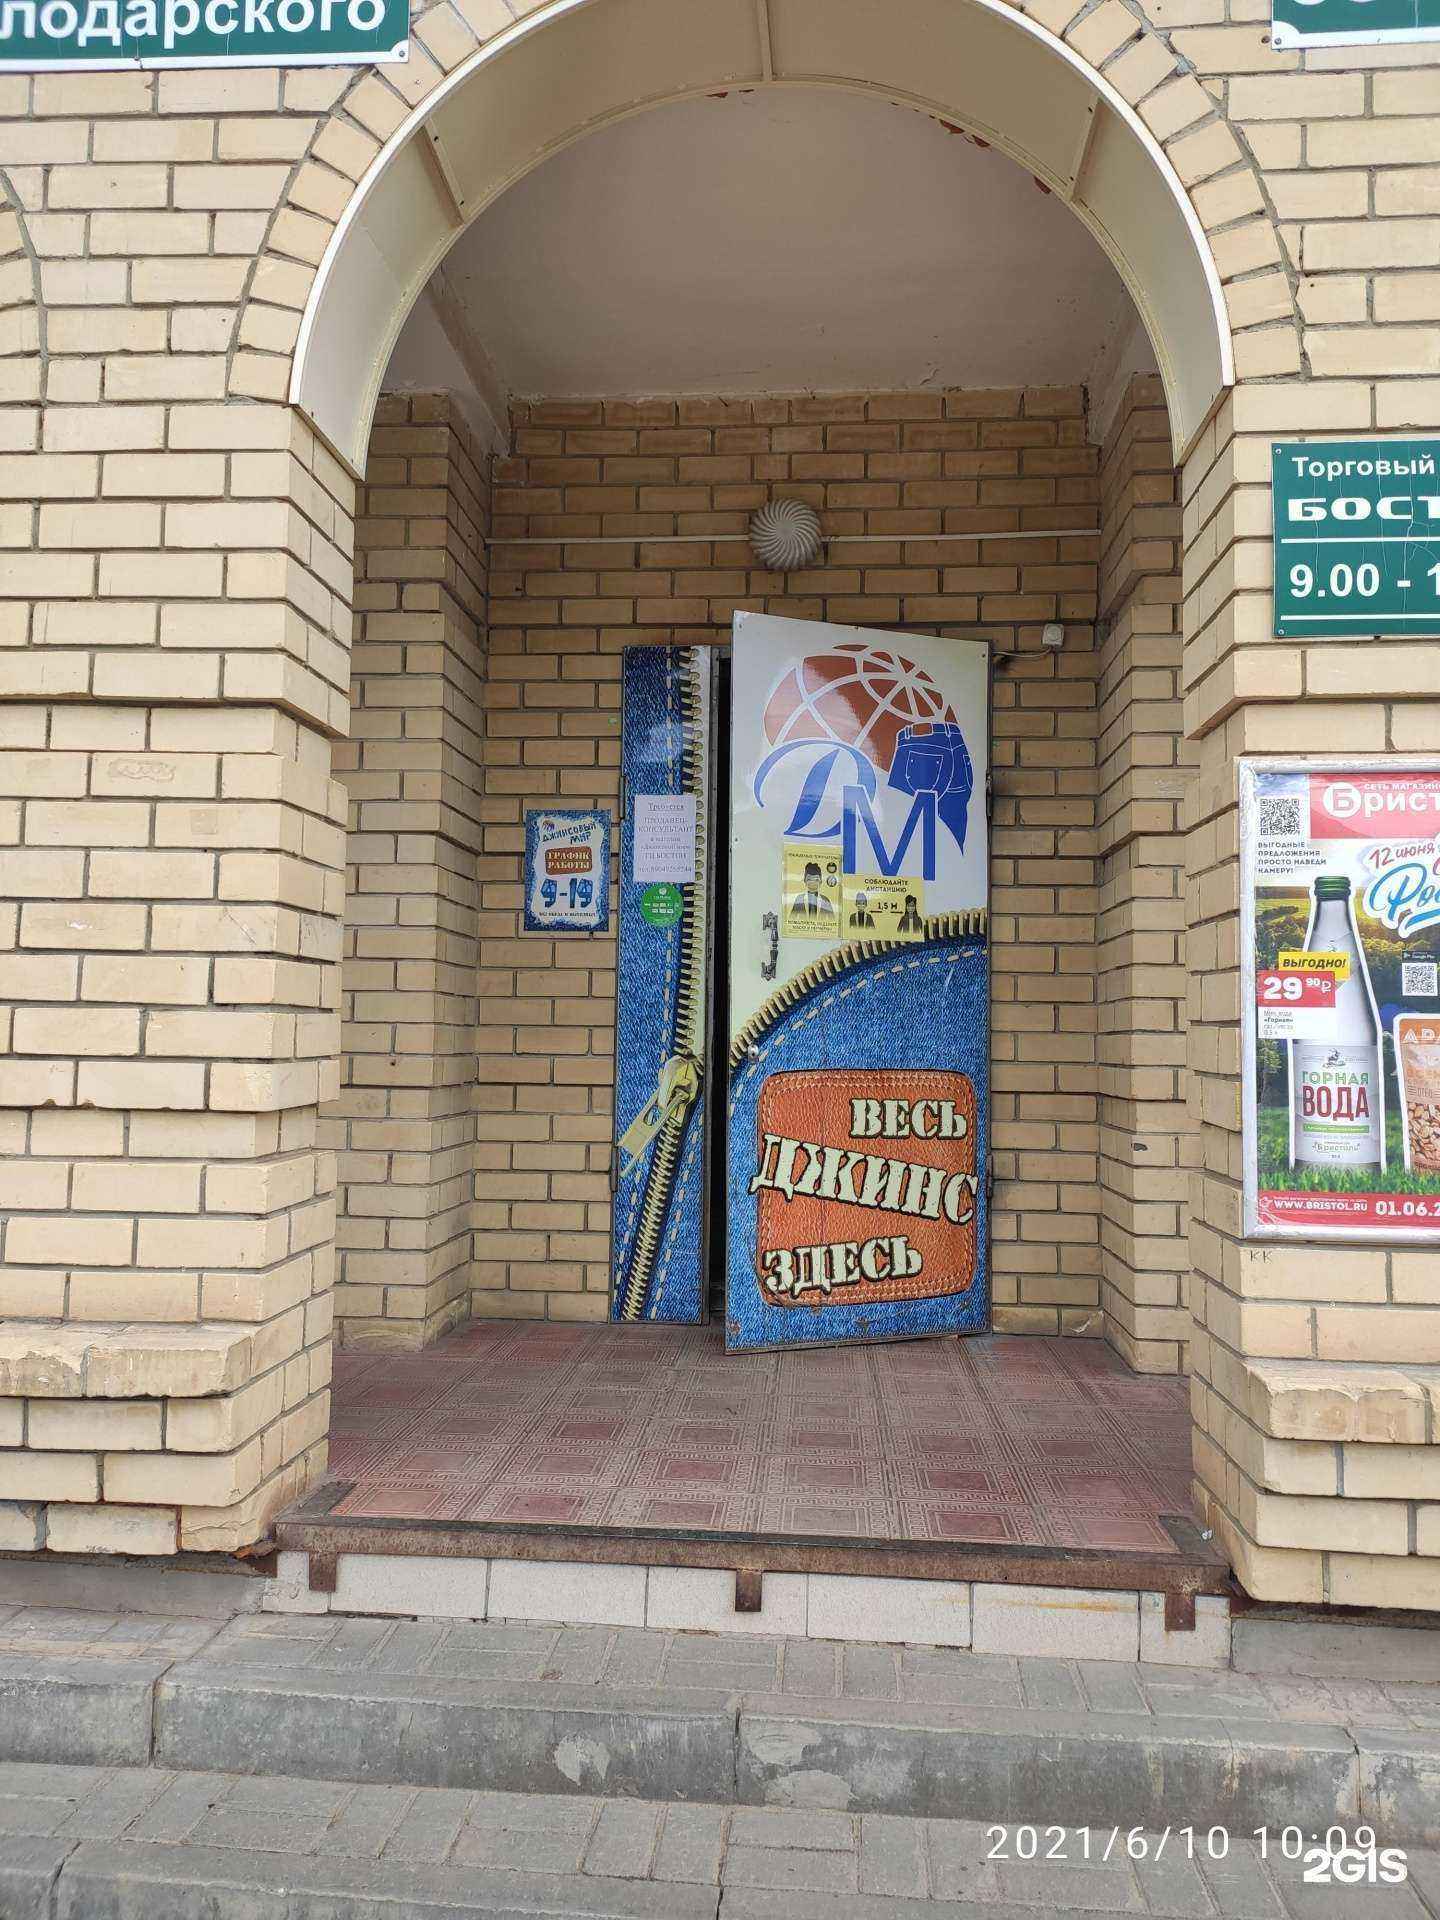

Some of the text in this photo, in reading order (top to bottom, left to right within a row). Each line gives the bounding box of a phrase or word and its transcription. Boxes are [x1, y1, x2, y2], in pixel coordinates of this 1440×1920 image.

[1291, 454, 1435, 481] Торговый
[1289, 564, 1380, 597] 9.00
[548, 851, 590, 860] ГРАФИК
[548, 861, 590, 869] РАБОТЫ
[1369, 843, 1435, 869] 12 июня
[541, 879, 593, 909] 9-19
[864, 878, 909, 886] СОБЛЮДАЙТЕ
[1283, 958, 1346, 969] ВЫГОДНО!
[1263, 976, 1303, 1000] 29
[1302, 1071, 1369, 1085] ГОРНАЯ
[1302, 1086, 1370, 1121] ВОДА
[850, 1098, 968, 1140] ВЕСЬ
[749, 1132, 979, 1225] ДЖИНС
[1273, 1200, 1368, 1211] WWW.BRISTOL.RU
[763, 1235, 923, 1297] ЗДЕСЬ
